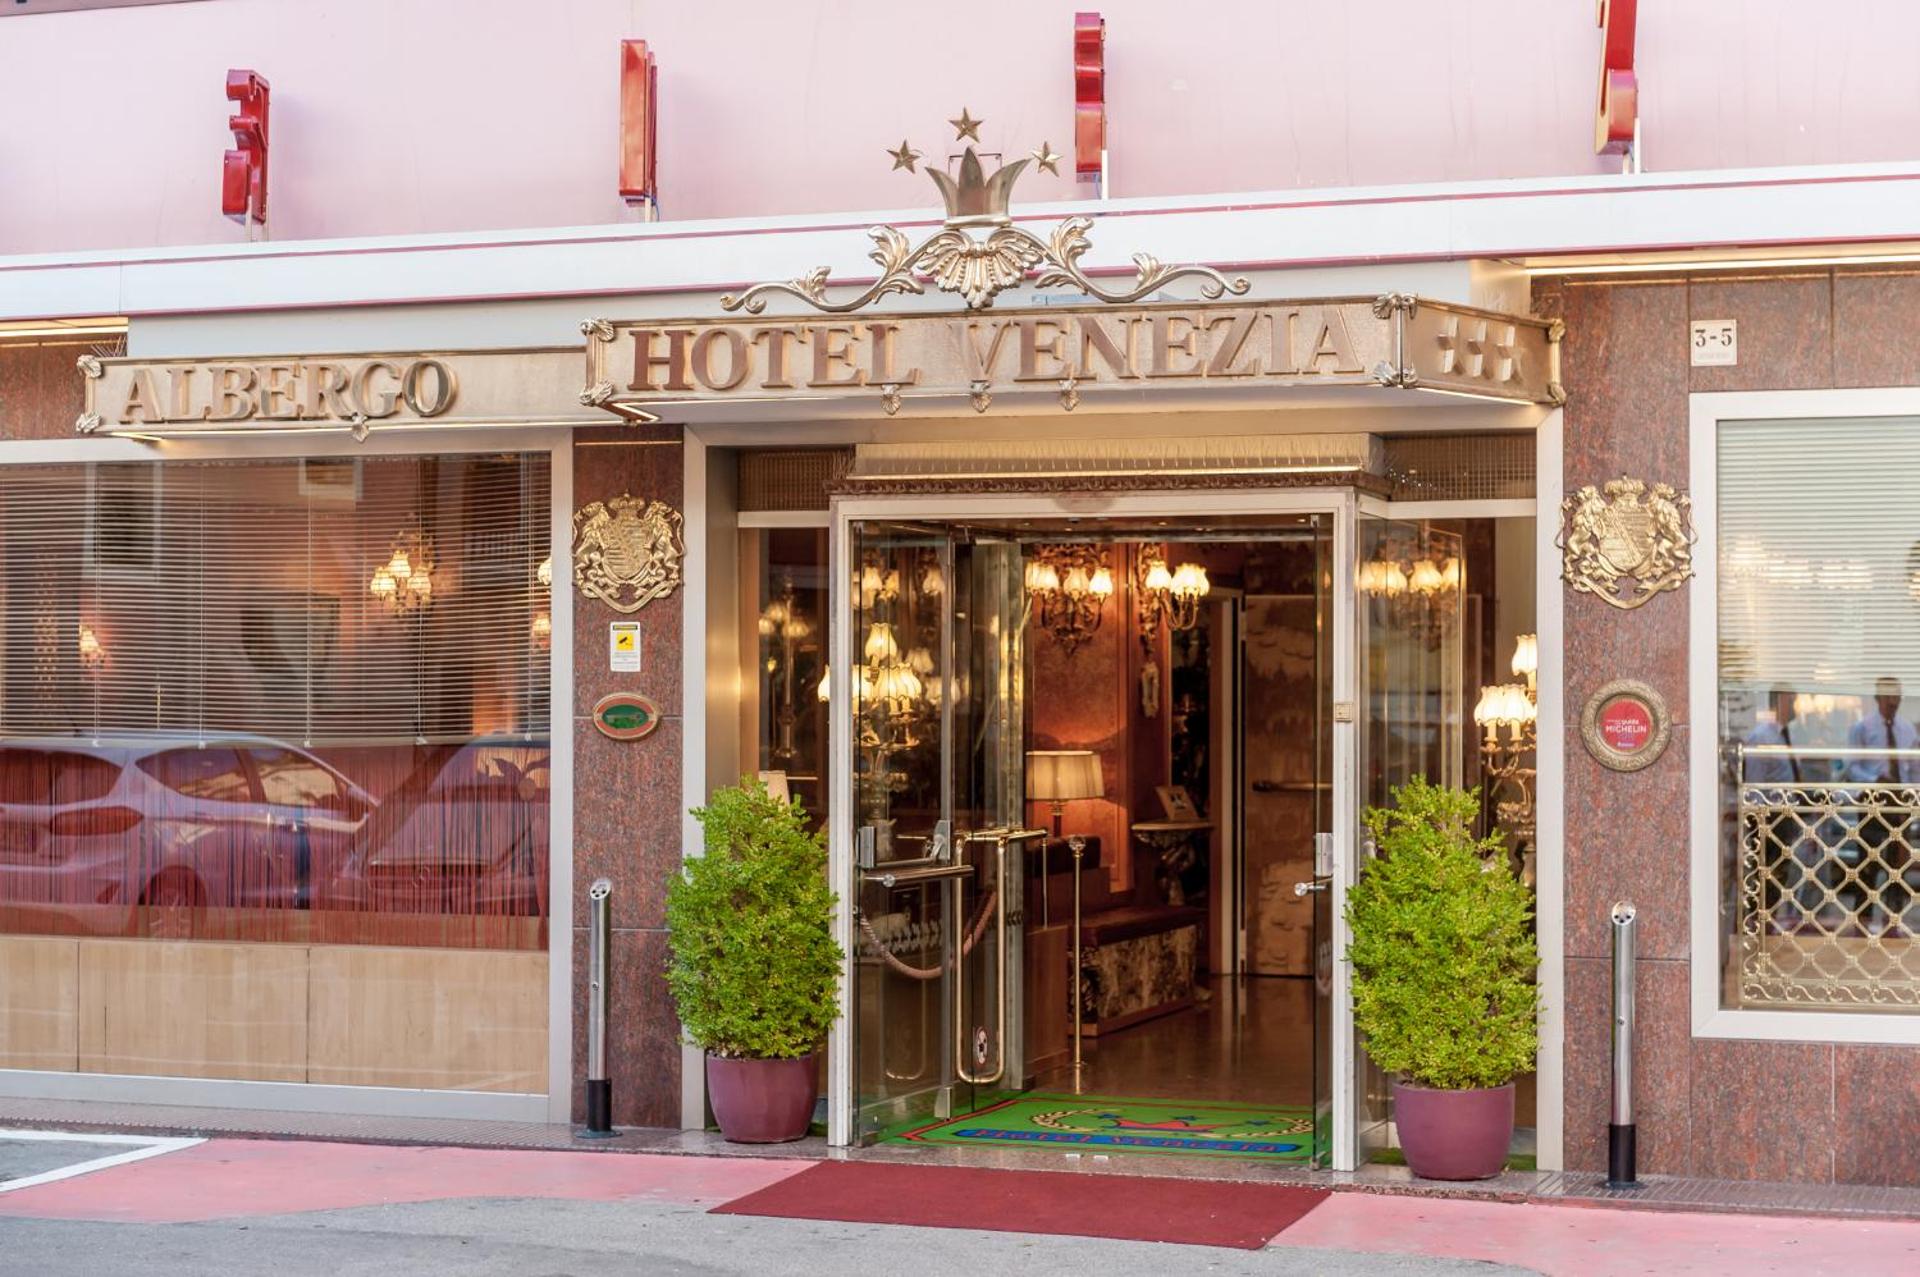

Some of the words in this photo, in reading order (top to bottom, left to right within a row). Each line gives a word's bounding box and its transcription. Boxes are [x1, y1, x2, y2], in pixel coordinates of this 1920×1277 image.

[627, 322, 922, 391] HOTEL
[946, 309, 1366, 382] VENEZIA
[1695, 327, 1732, 347] 3-5
[119, 360, 457, 424] ALBERGO
